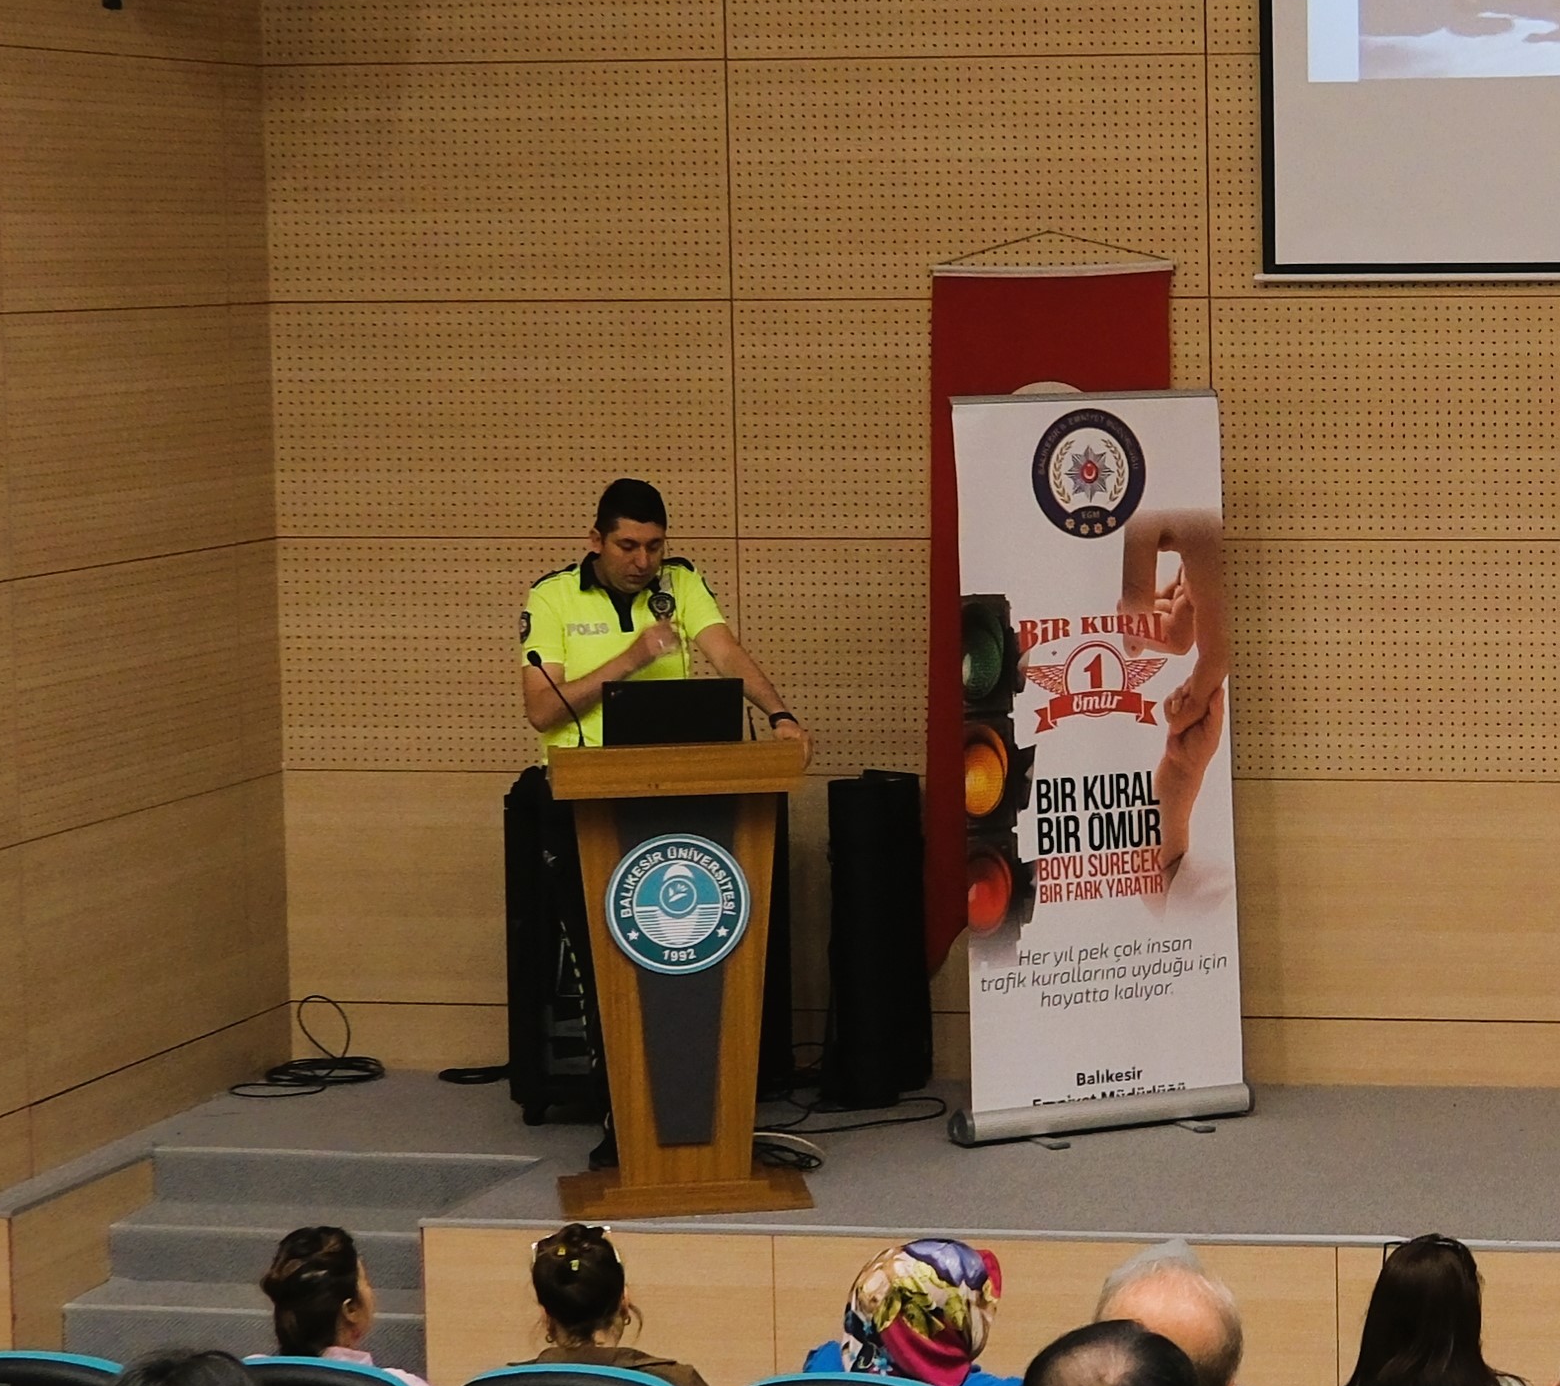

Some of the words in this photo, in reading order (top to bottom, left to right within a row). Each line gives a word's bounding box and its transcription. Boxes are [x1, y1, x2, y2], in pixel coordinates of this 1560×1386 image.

[1080, 613, 1168, 644] KURAL
[1083, 653, 1103, 689] 1
[1083, 770, 1160, 811] KURAL
[1038, 855, 1083, 882] BOYU
[619, 851, 665, 918] BALIKESİR
[1066, 879, 1104, 902] FARK
[1106, 874, 1164, 898] YARATIR
[662, 948, 697, 961] 1992
[1018, 950, 1051, 967] Her
[1053, 945, 1074, 968] yıl
[1077, 942, 1110, 965] pek
[1113, 939, 1142, 964] çok
[1146, 937, 1193, 954] insan
[980, 972, 1027, 994] trafik
[1031, 964, 1127, 987] kurallarına
[1131, 957, 1194, 981] uyduğu
[1198, 953, 1228, 975] için
[1039, 987, 1109, 1010] hayatta
[1076, 1067, 1144, 1087] Balıkesir
